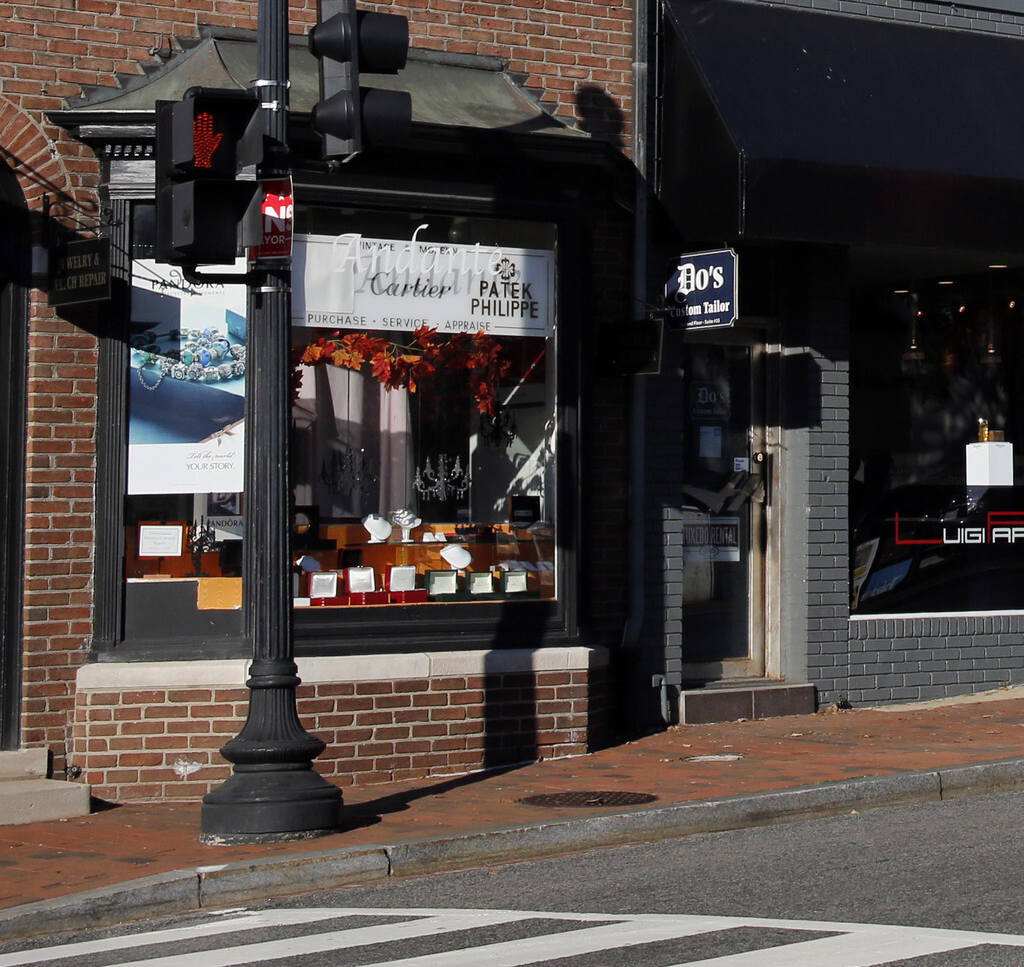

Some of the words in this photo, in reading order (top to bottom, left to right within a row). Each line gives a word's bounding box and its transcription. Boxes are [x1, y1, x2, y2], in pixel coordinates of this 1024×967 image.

[334, 224, 503, 276] Andante
[79, 271, 107, 288] REPAIR
[370, 271, 452, 299] Cartier
[675, 263, 724, 303] Do's
[480, 280, 533, 300] PATEK
[471, 298, 539, 319] PHILIPPE
[703, 299, 730, 314] Tailor
[307, 313, 367, 326] PURCHASE
[382, 317, 428, 329] SERVICE
[445, 320, 491, 332] APPRAISE
[186, 462, 208, 470] YOUR
[210, 519, 244, 527] ANDORA
[895, 512, 985, 544] LUIGI
[710, 527, 737, 544] RENTAL
